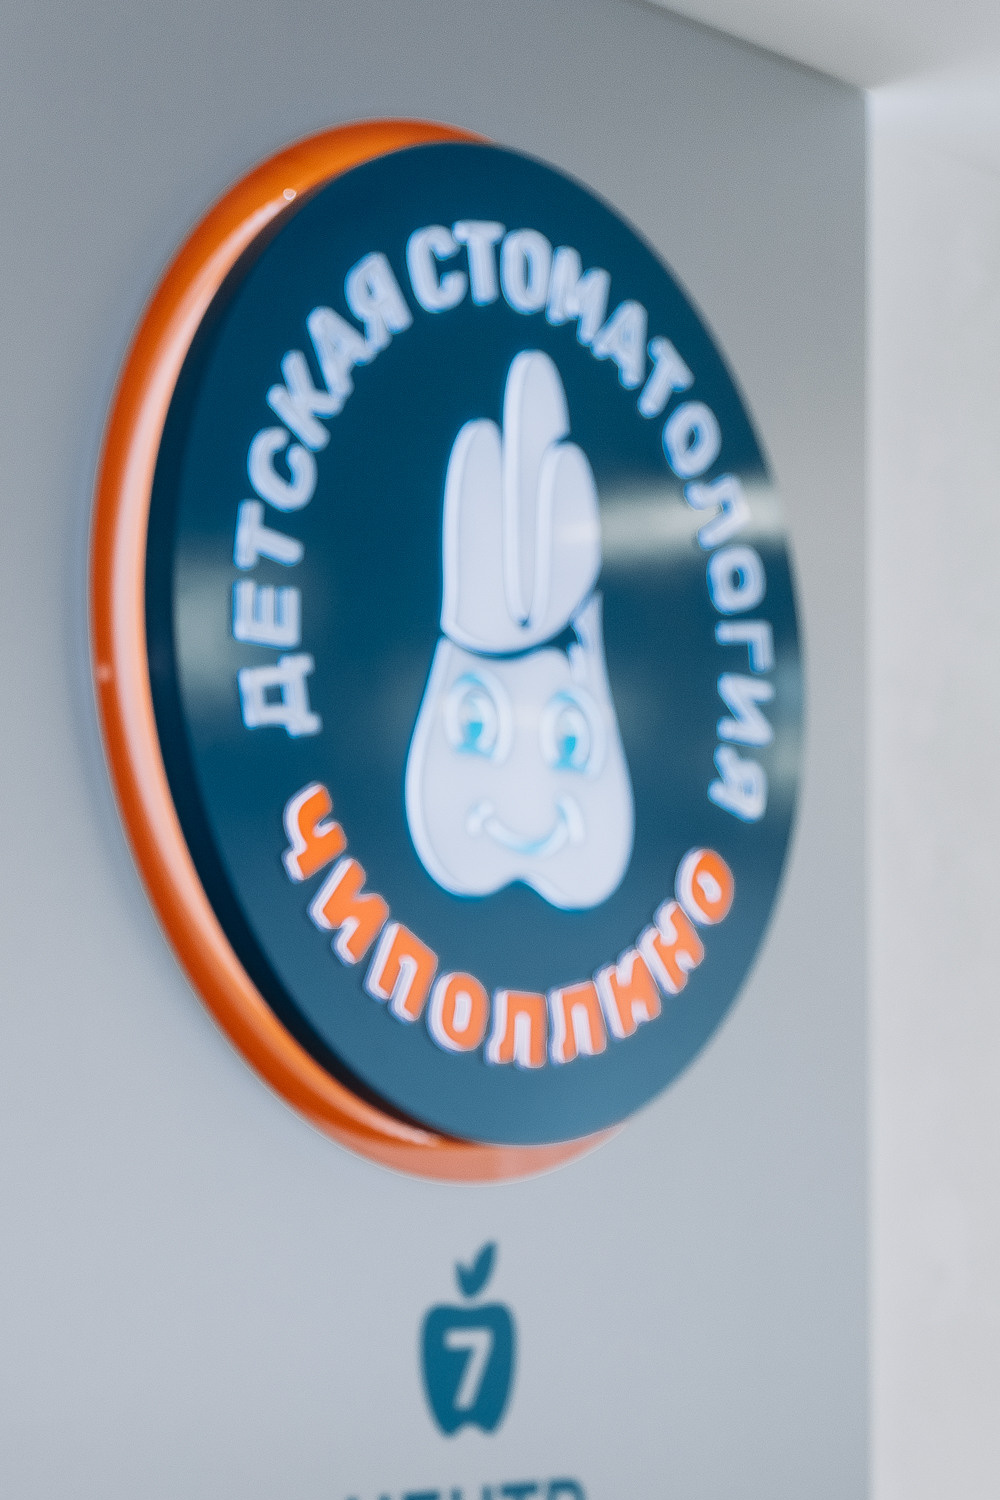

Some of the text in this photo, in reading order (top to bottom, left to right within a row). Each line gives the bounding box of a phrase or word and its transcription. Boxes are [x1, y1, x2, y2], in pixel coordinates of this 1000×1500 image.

[232, 219, 775, 823] ДЕТСКАЯ СТОМАТОЛОГИЯ
[282, 781, 735, 1069] ЧИПОЛЛИНО
[443, 1327, 495, 1412] 7
